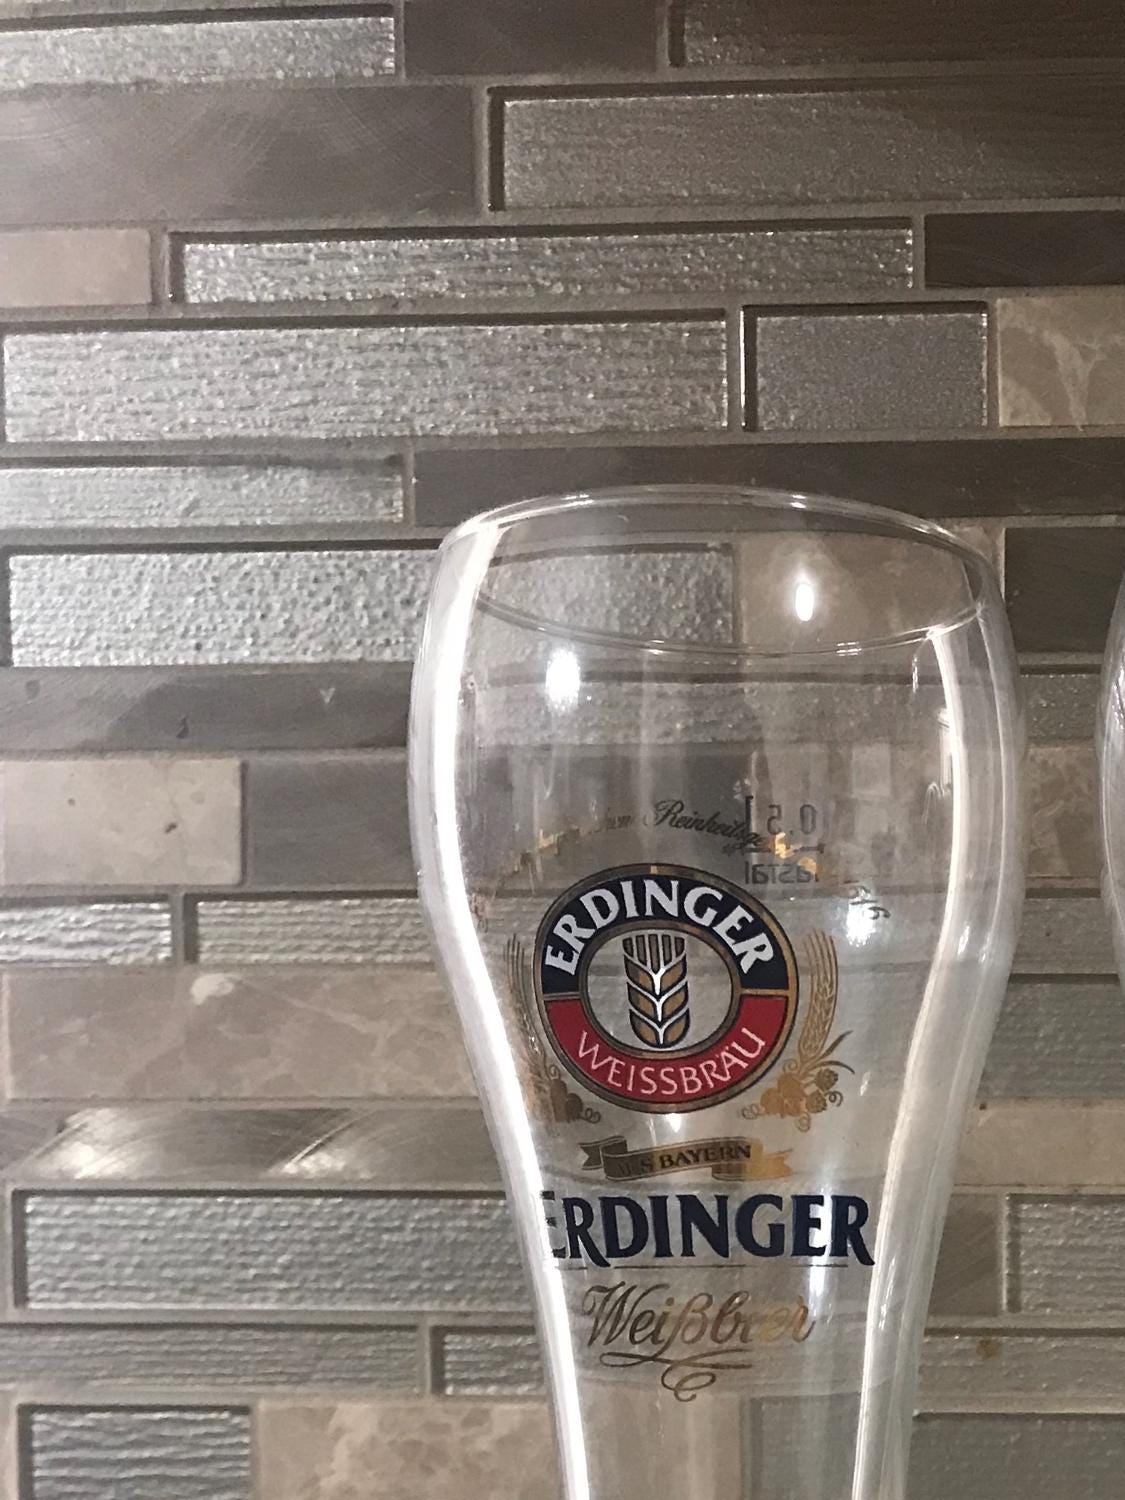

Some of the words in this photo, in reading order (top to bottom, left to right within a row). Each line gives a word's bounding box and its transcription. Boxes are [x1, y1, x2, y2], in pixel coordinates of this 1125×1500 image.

[545, 878, 776, 976] ERDINGER
[577, 1028, 767, 1097] WEISSBRÄU
[659, 1143, 752, 1168] BAYERN
[541, 1190, 875, 1266] ERDINGER
